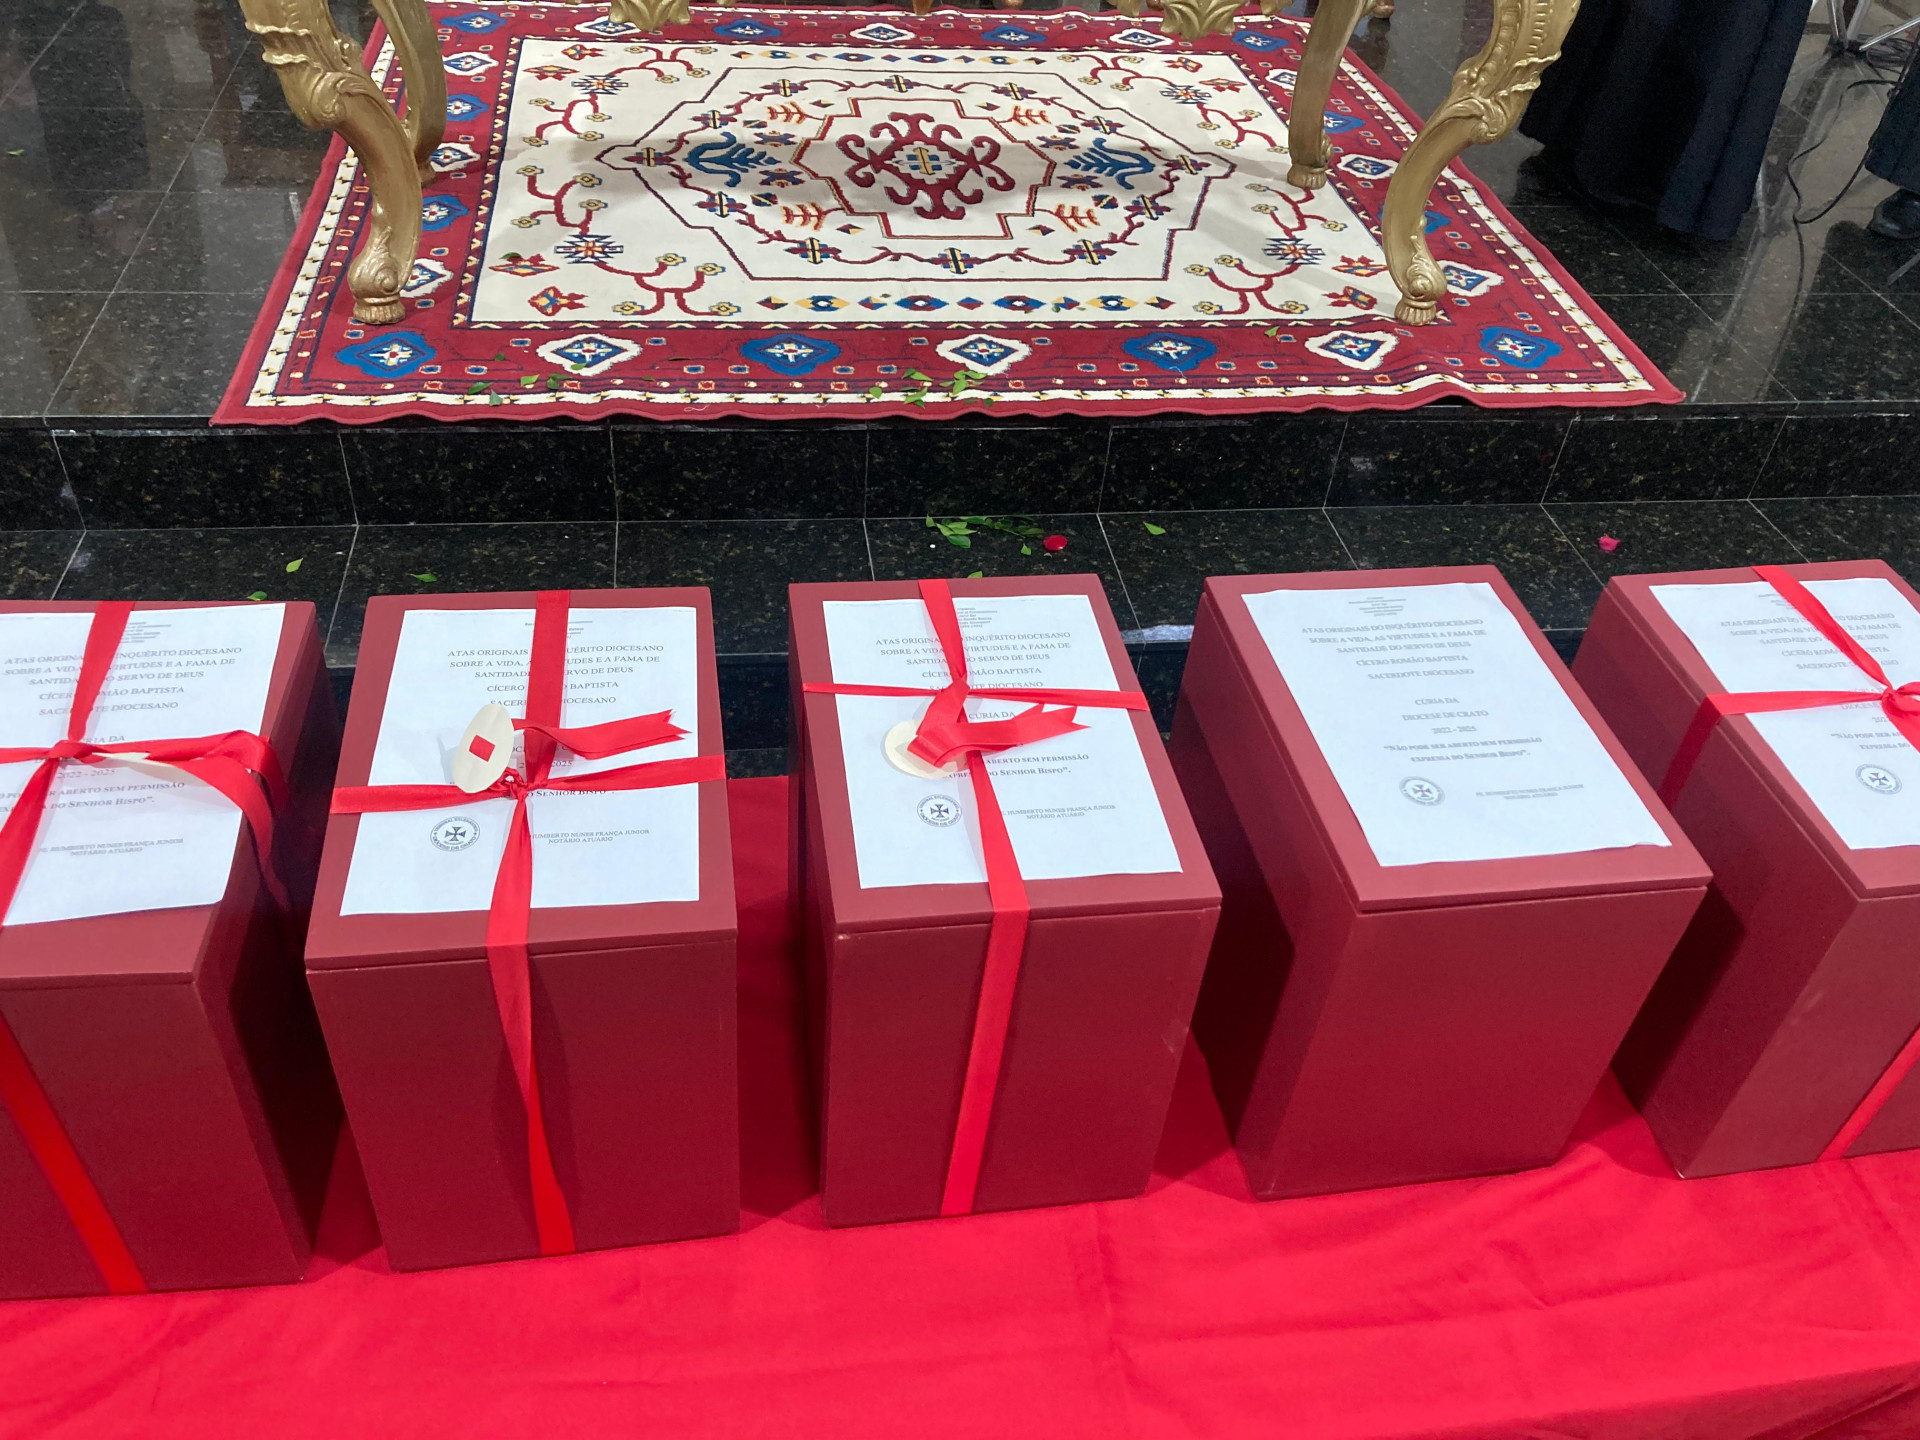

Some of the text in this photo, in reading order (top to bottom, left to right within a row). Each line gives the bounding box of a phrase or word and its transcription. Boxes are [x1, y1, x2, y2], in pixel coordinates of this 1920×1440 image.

[37, 654, 84, 663] ORIGINA
[178, 648, 242, 656] DIOCESANO
[4, 667, 41, 675] SOBRE
[130, 687, 184, 695] BAPTISTA
[111, 702, 178, 711] DIOCESANO
[968, 711, 1000, 720] CÚRIA
[1042, 754, 1089, 762] PERMISSÃO
[128, 782, 184, 791] PERMISSÃO
